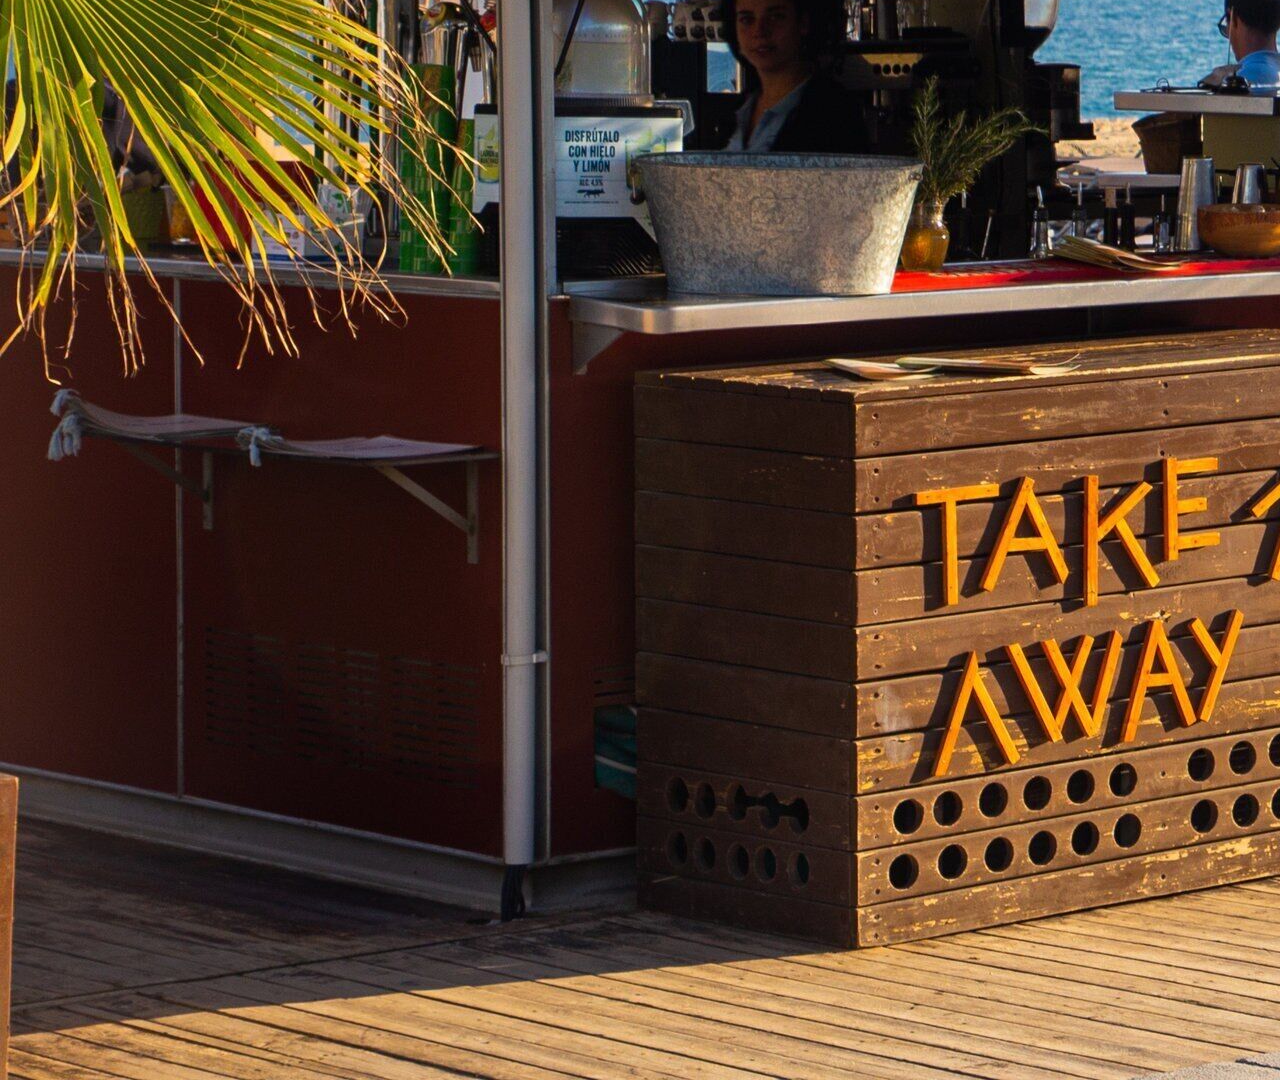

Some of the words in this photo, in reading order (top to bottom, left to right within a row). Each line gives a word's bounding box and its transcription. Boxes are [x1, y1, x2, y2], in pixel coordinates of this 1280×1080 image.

[565, 127, 620, 143] DISFRÚTALO
[568, 145, 587, 158] CON
[590, 145, 615, 158] HIELO
[573, 160, 579, 172] Y
[582, 157, 610, 173] LIMÓN
[914, 456, 1220, 607] TAKE
[931, 608, 1244, 777] AWAY
